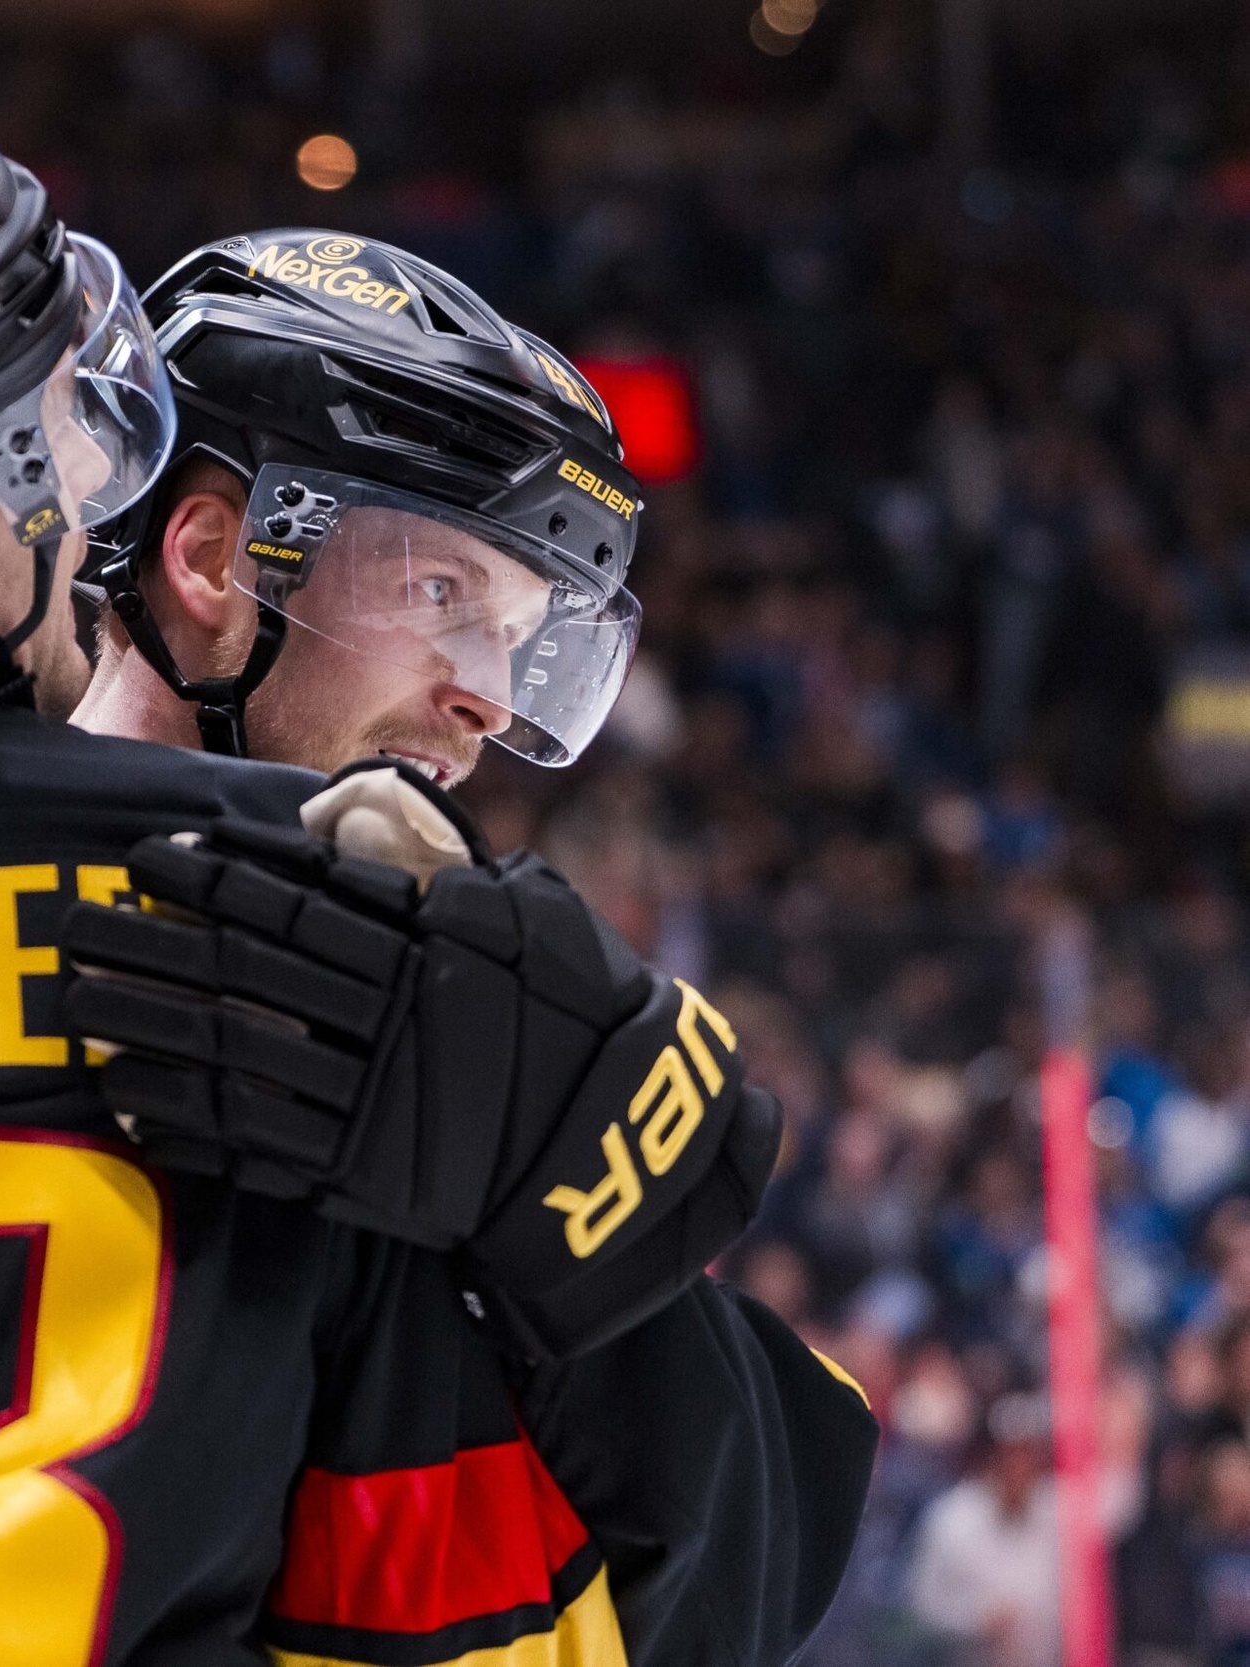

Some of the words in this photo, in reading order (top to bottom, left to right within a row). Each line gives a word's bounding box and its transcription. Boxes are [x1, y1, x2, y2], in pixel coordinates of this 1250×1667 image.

[246, 245, 410, 315] NexGen
[558, 459, 635, 521] BAUER
[248, 542, 303, 561] BAUER
